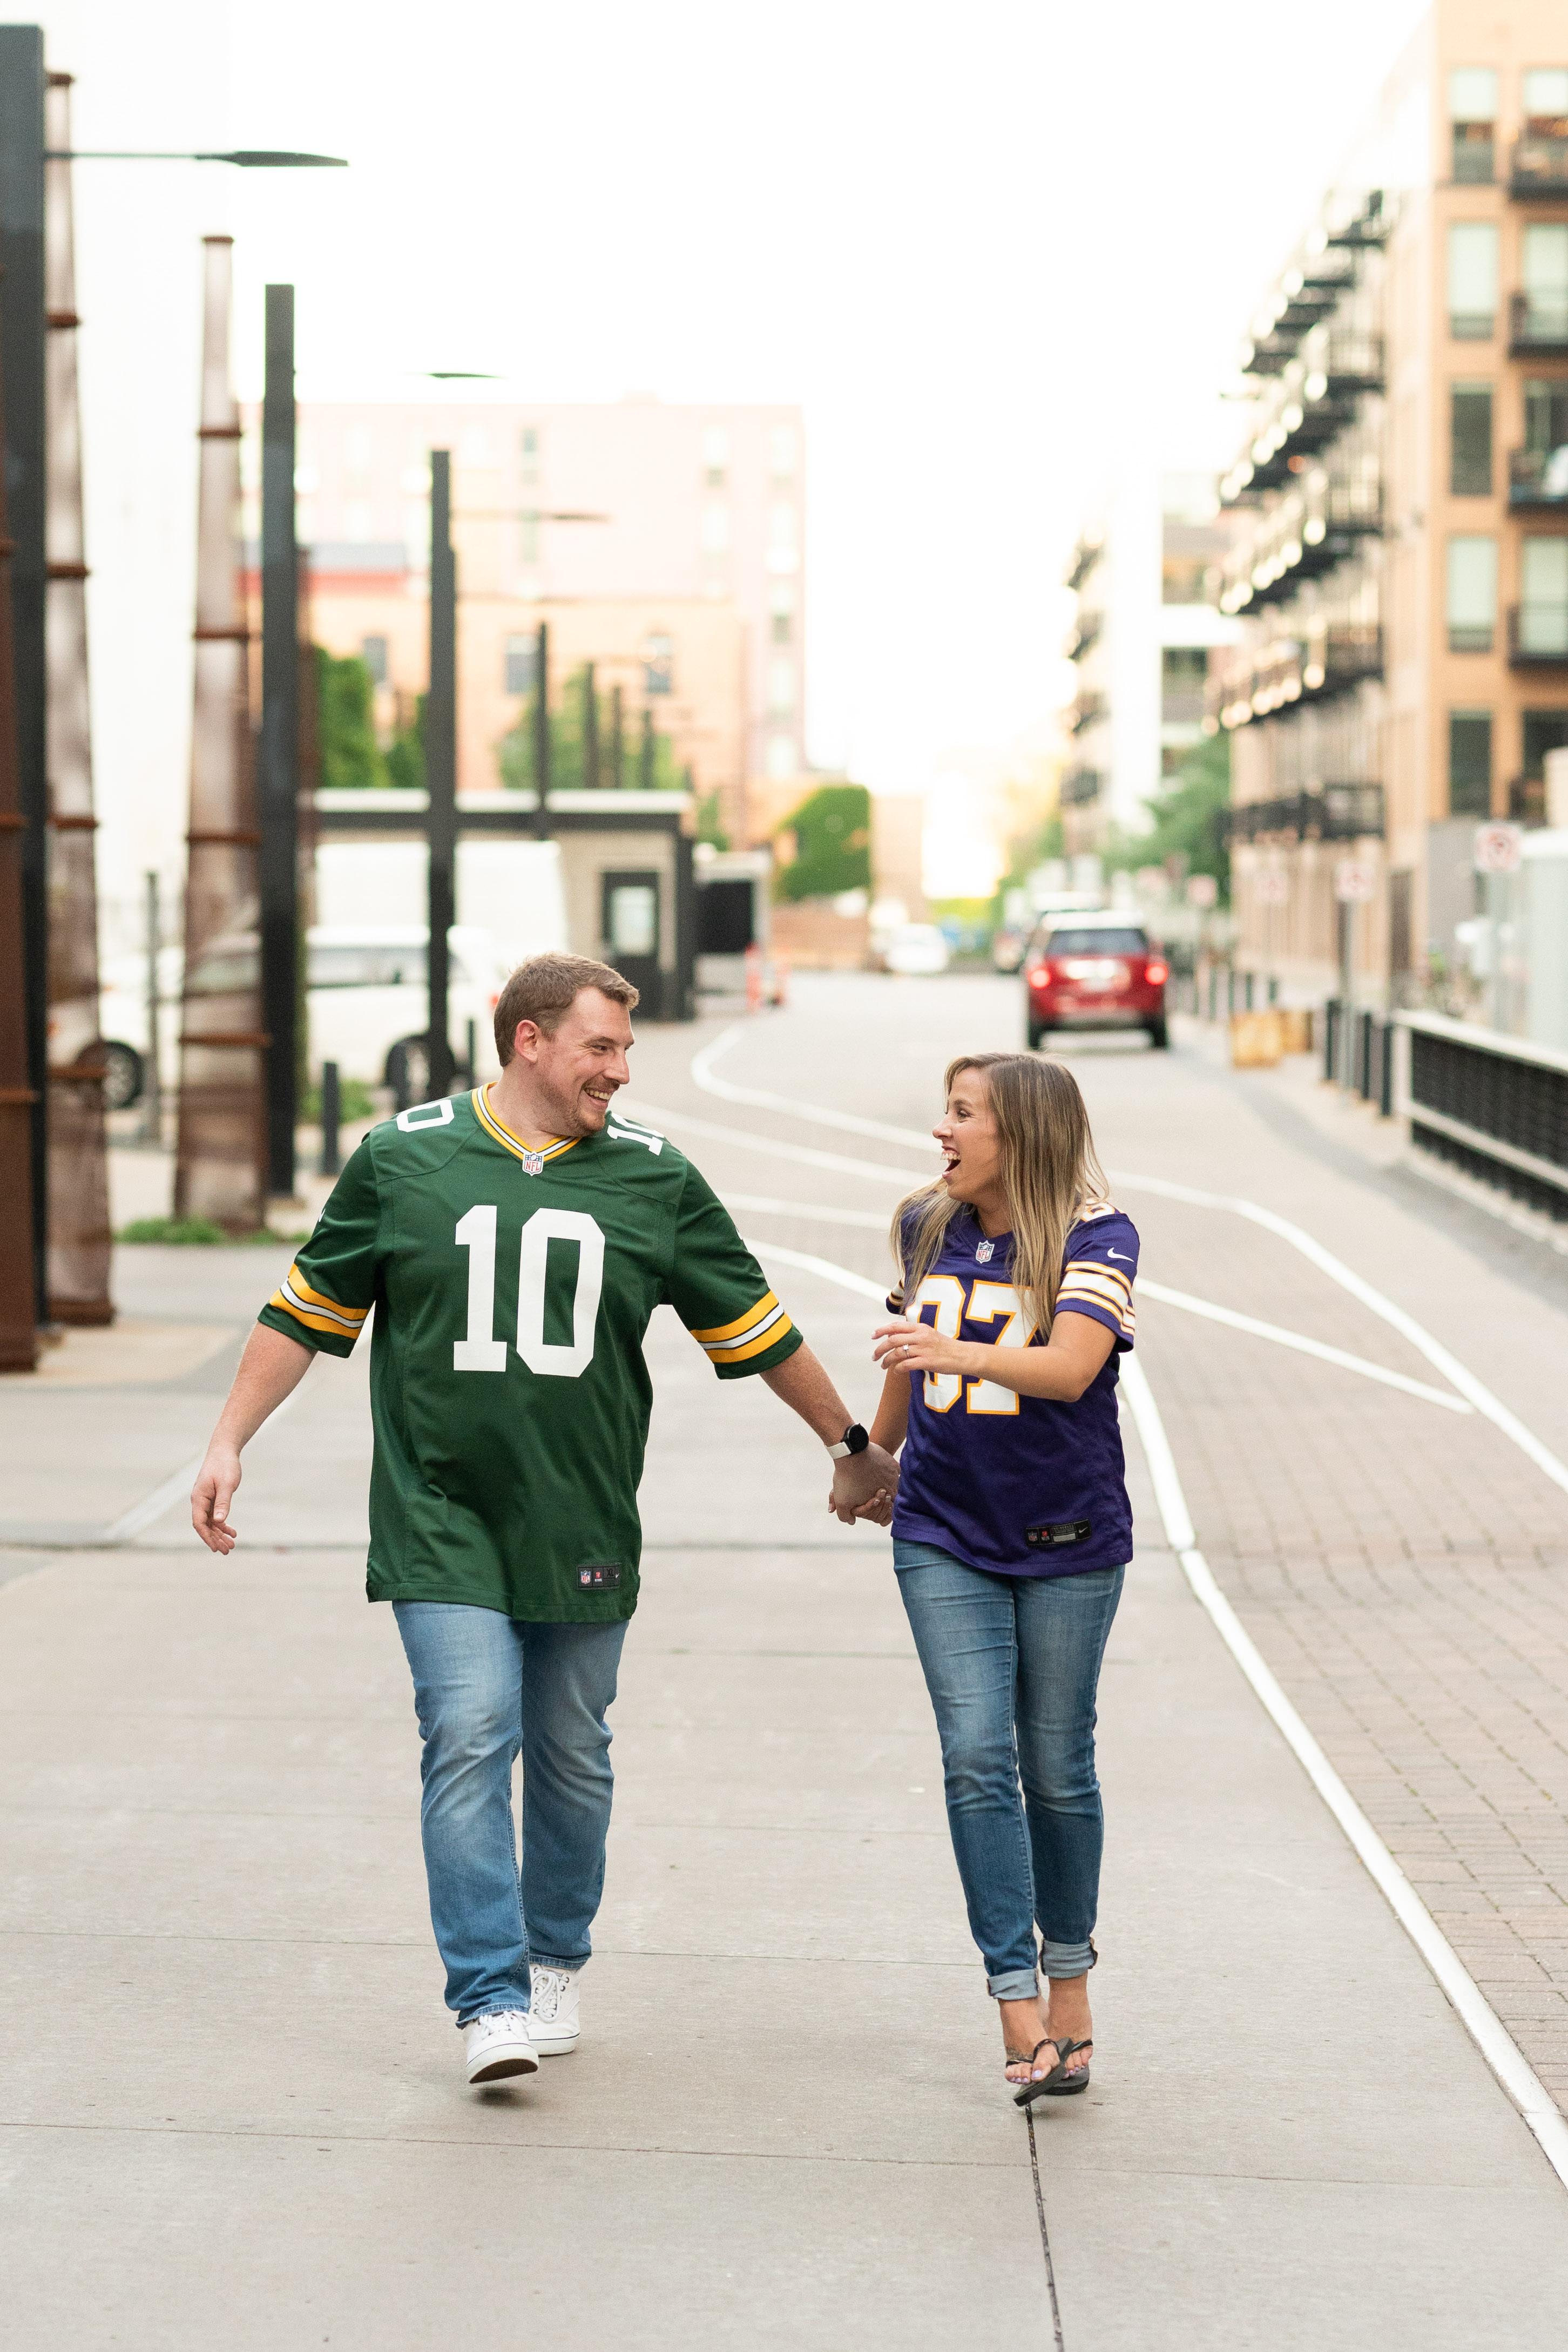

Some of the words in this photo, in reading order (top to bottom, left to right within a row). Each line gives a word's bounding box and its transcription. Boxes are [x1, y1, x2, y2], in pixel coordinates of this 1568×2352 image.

[525, 1161, 540, 1171] NFL
[978, 1251, 989, 1259] NFL
[454, 1205, 606, 1377] 10
